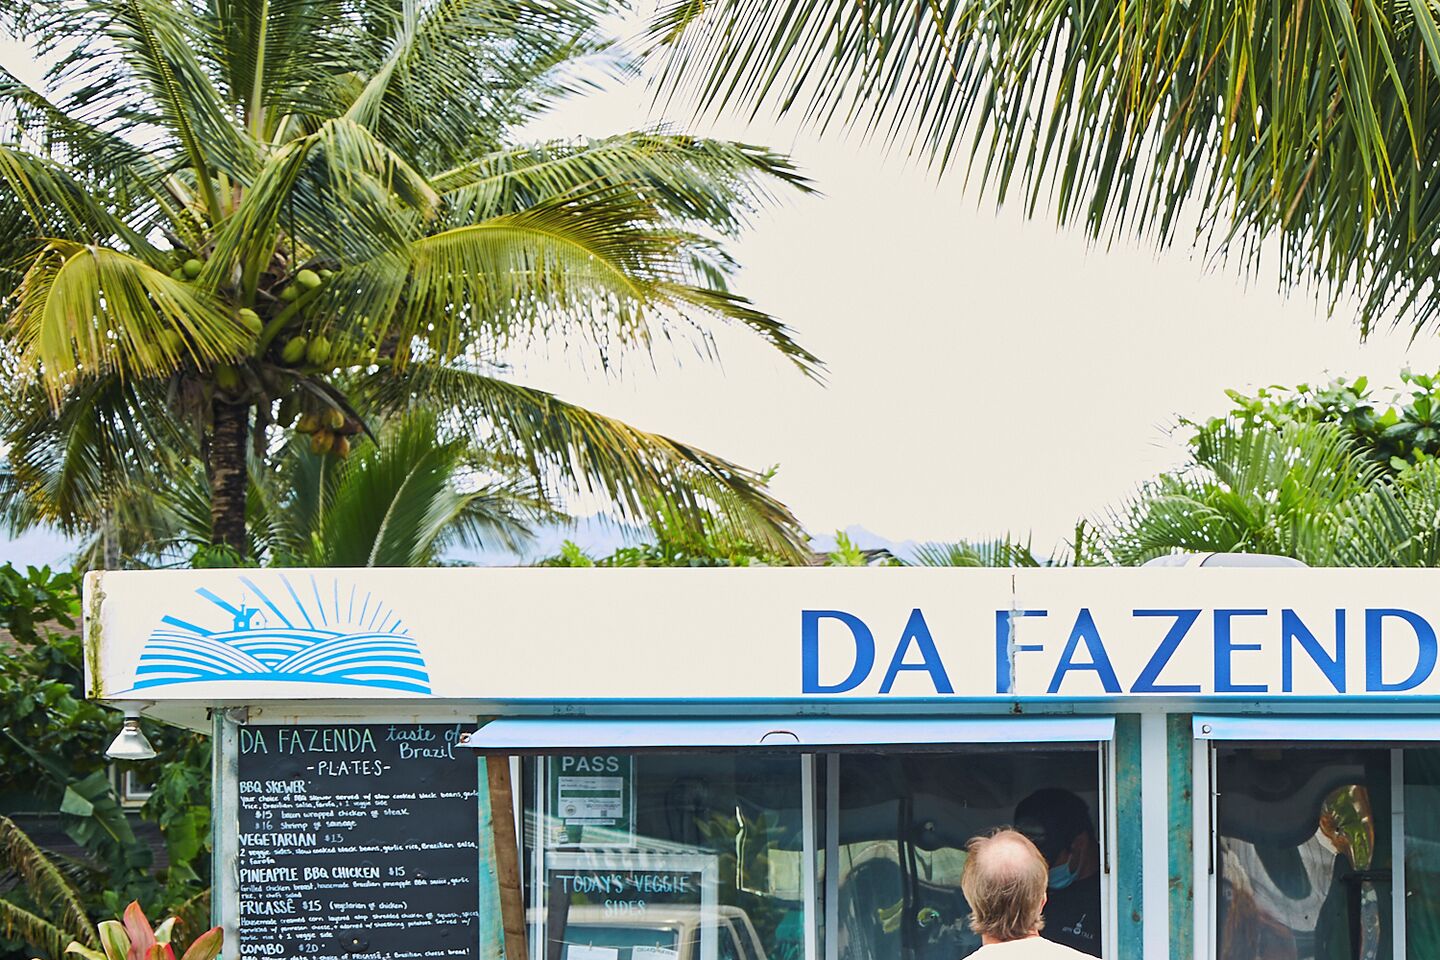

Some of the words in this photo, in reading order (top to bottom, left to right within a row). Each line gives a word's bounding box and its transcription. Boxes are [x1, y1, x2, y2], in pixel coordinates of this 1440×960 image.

[801, 607, 955, 695] DA
[240, 728, 268, 754] DA
[279, 728, 377, 754] FAZENDA
[385, 725, 436, 742] taste
[444, 723, 461, 744] of
[399, 742, 456, 760] Brazil
[562, 756, 619, 772] PASS
[240, 780, 263, 794] BBQ
[255, 810, 273, 819] $15
[303, 810, 334, 819] wrapped
[338, 810, 367, 818] chicken
[383, 808, 410, 816] steak
[255, 821, 273, 830] $16
[280, 821, 308, 832] shrimp
[239, 833, 317, 847] VEGETARIAN
[324, 833, 344, 843] $13
[239, 867, 299, 883] PINEAPPLE
[303, 867, 330, 881] BBQ
[331, 866, 380, 879] CHICKEN
[388, 866, 406, 876] $15
[556, 875, 629, 895] TODAY'S
[633, 876, 689, 893] VEGGIE
[302, 900, 322, 912] $15
[378, 901, 408, 910] chicken)
[604, 900, 646, 918] SIDES
[240, 943, 285, 955] COMBO
